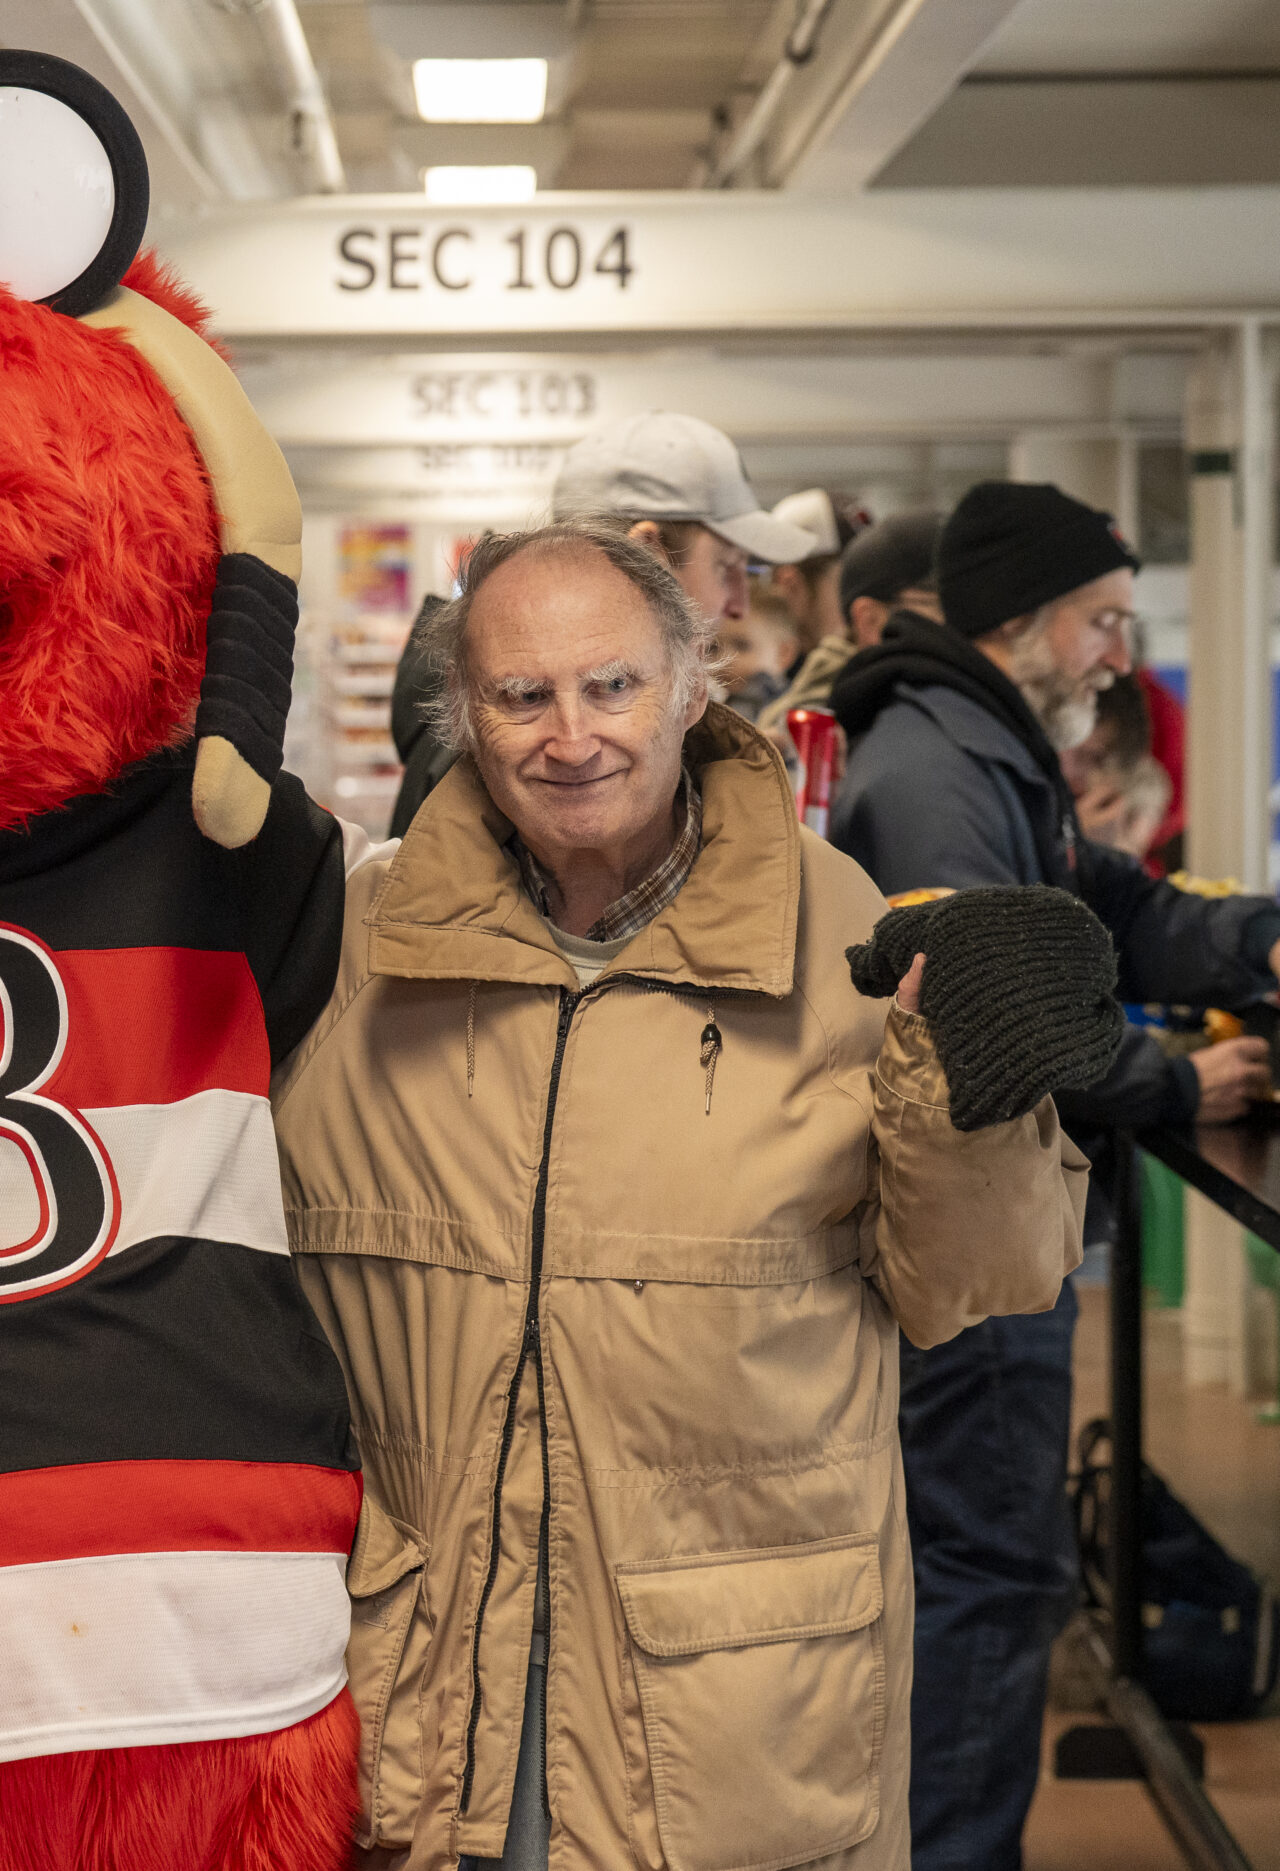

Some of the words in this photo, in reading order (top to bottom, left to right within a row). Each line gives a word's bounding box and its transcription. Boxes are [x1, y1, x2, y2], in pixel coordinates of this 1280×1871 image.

[337, 228, 472, 290] SEC
[506, 228, 632, 290] 104
[410, 372, 493, 417] SEC
